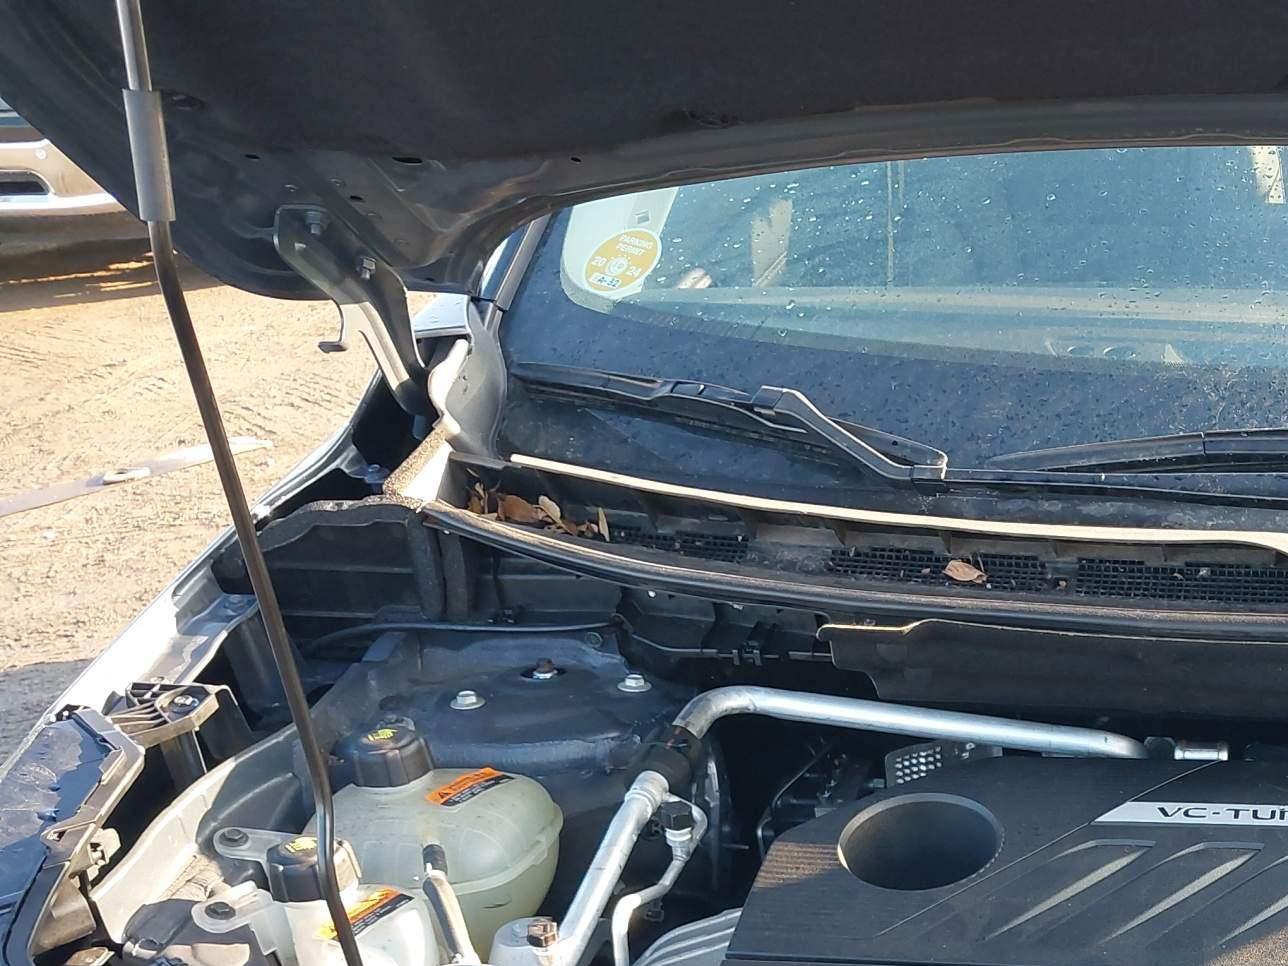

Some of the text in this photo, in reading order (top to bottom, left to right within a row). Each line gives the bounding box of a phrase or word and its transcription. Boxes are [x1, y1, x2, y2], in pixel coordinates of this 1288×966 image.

[619, 234, 654, 249] PARKING
[615, 243, 647, 256] PERMIT
[591, 256, 607, 266] 20
